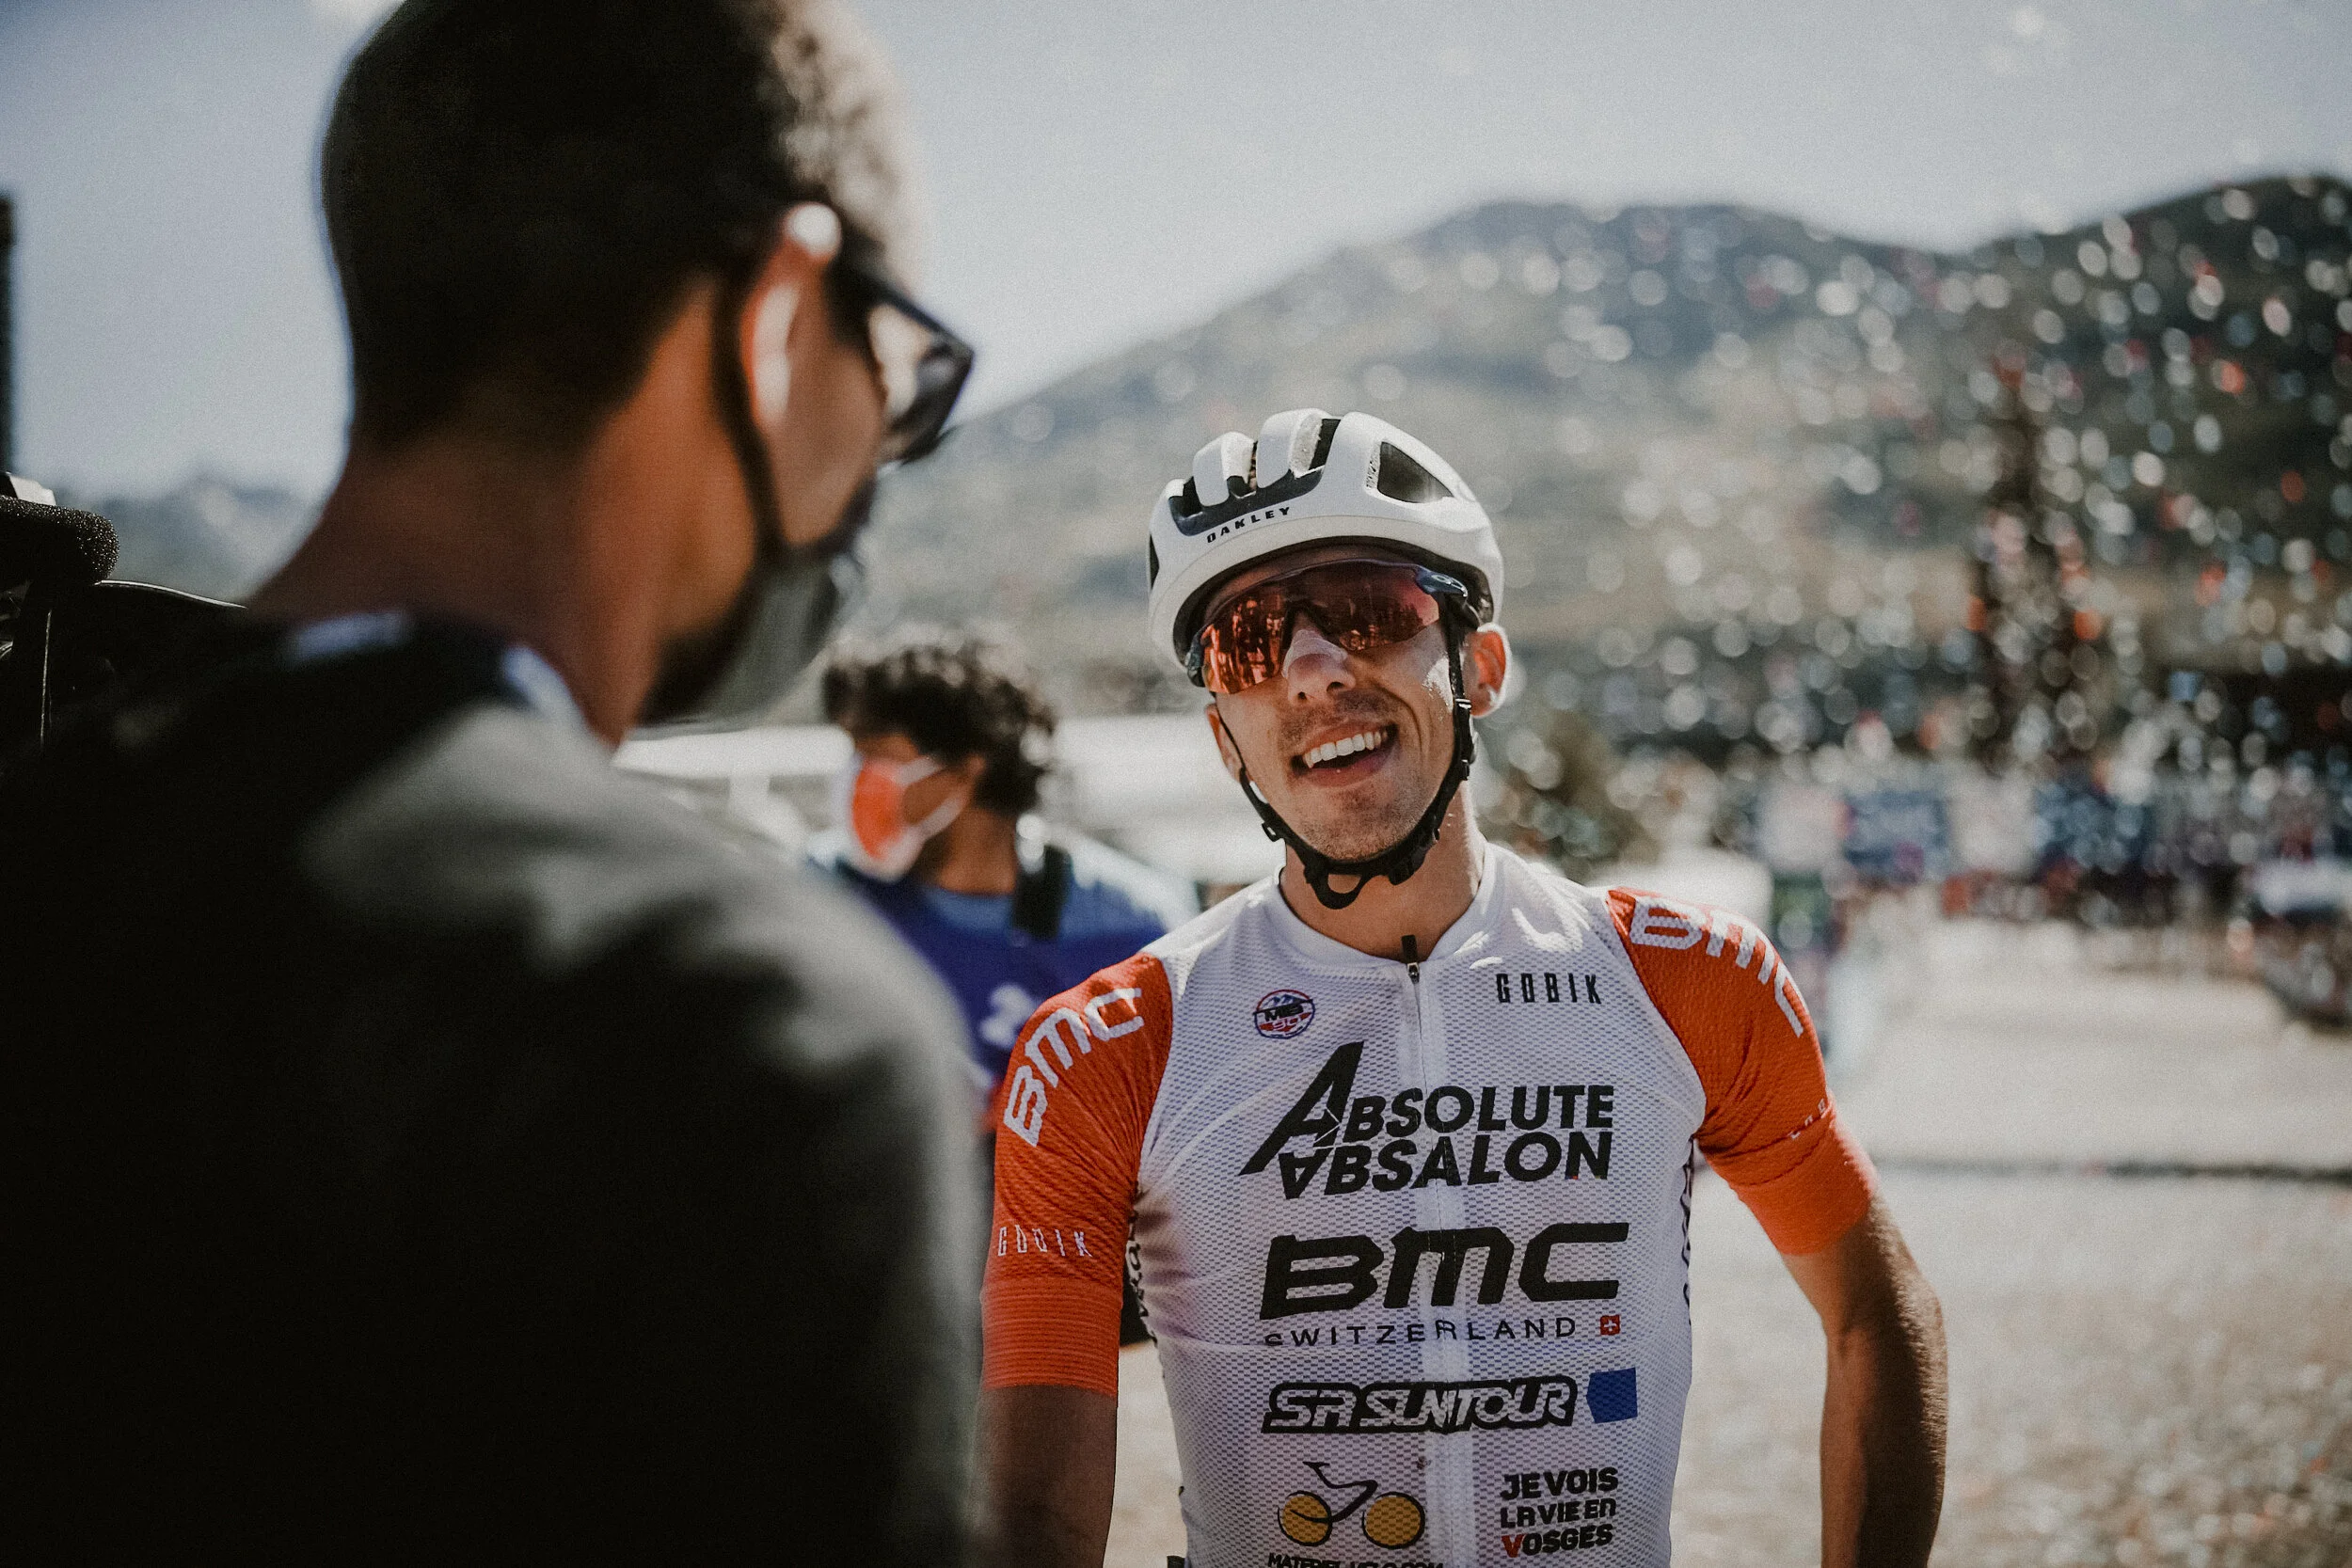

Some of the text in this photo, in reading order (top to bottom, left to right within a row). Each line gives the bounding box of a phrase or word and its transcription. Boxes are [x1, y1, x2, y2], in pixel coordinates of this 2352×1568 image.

[1206, 506, 1290, 544] OAKLEY
[1629, 895, 1811, 1038] BMC
[1495, 972, 1602, 1005] GOBIK
[1003, 987, 1144, 1148] BMC
[1239, 1040, 1614, 1177] ABSOLUTE
[1278, 1132, 1613, 1200] ABSALON
[1260, 1222, 1629, 1320] BMC
[1264, 1317, 1576, 1347] SWITZERLAND
[1500, 1466, 1619, 1500] JE VOIS
[1500, 1506, 1536, 1528] LA
[1537, 1500, 1581, 1525] VIE
[1501, 1523, 1614, 1559] VOSGES
